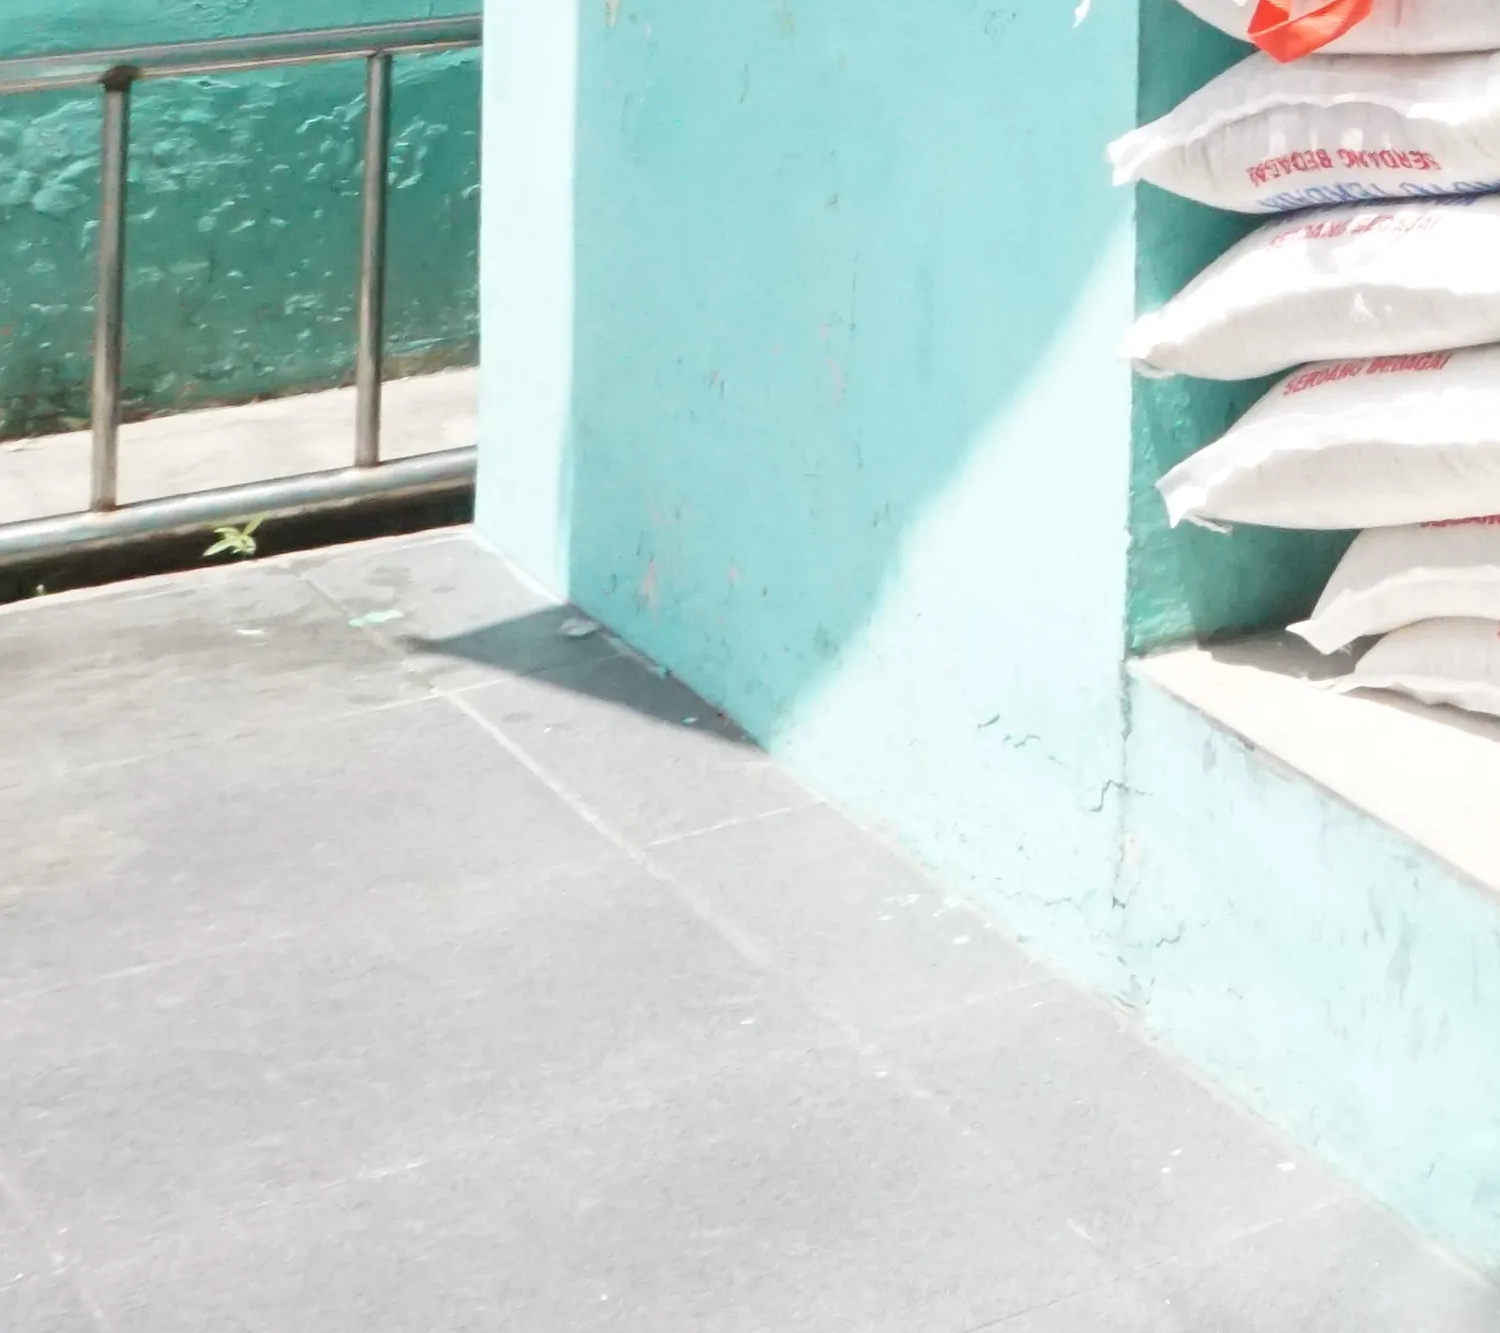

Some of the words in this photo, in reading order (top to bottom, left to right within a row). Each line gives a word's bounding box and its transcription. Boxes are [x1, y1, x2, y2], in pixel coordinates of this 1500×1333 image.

[1246, 147, 1334, 188] BEDAGAI
[1336, 147, 1443, 173] SERDANG
[1282, 357, 1363, 397] SERDANG
[1367, 352, 1452, 377] BEDAGAI
